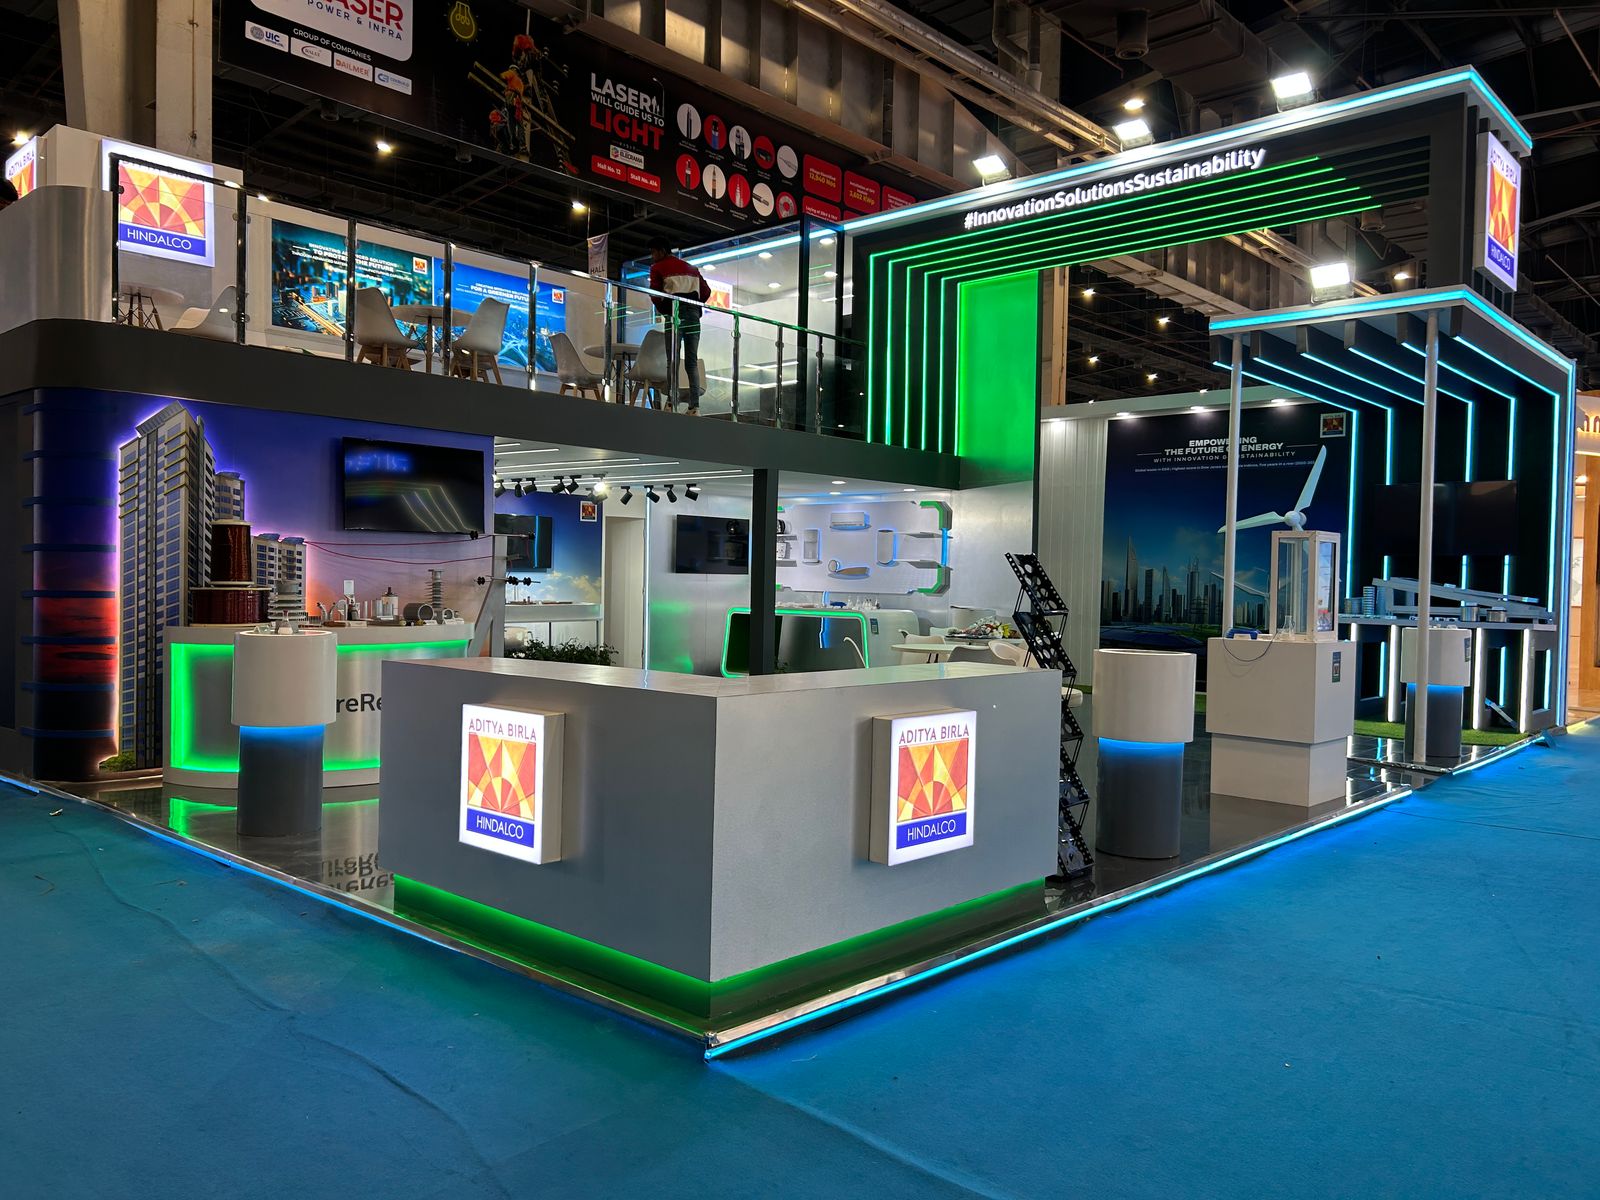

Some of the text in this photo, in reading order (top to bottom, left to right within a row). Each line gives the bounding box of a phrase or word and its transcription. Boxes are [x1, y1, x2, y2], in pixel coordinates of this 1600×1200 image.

[307, 0, 350, 20] POWER
[368, 23, 402, 41] INFRA
[265, 30, 280, 43] UIC
[293, 28, 372, 61] GROUP OF COMPANIES
[336, 58, 369, 77] DAILMER
[591, 72, 651, 113] LASER
[591, 91, 665, 127] WILL GUIDE US TO
[590, 102, 665, 150] LIGHT
[963, 148, 1266, 230] #InnovationSolutionsSustainability
[127, 228, 192, 250] HINDALCO
[313, 248, 324, 256] TO
[355, 258, 369, 266] THE
[369, 261, 394, 272] FUTURE
[1490, 242, 1512, 272] HINDALCO
[591, 265, 605, 274] HALL
[488, 289, 514, 299] GREENER
[1164, 442, 1284, 456] THE FUTURE ENERGY
[1189, 436, 1257, 448] EMPOWEING
[469, 718, 537, 741] ADITYA BIRLA
[899, 724, 970, 745] ADITYA BIRLA
[476, 815, 524, 840] HINDALCO
[907, 820, 956, 842] HINDALCO
